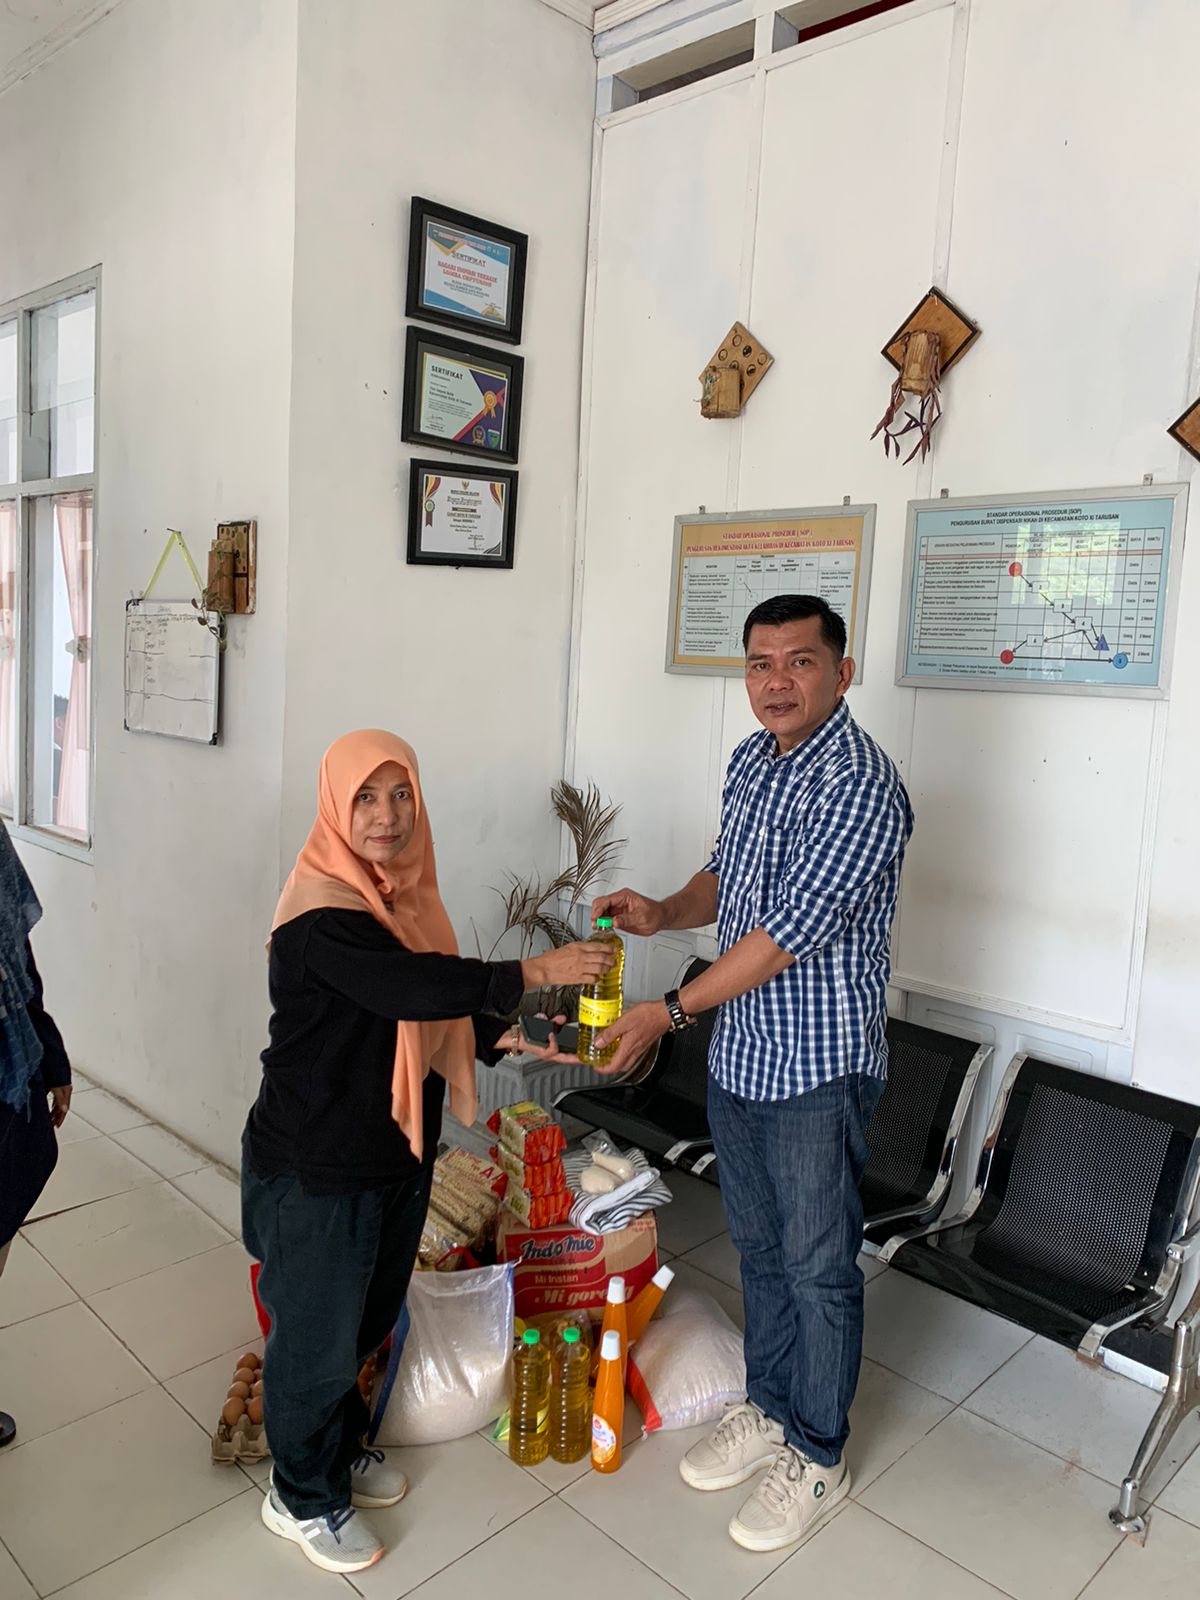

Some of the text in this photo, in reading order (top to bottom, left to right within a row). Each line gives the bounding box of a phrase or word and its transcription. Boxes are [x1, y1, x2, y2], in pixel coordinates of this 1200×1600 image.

[431, 365, 463, 380] SERTIFIKAT
[535, 1273, 579, 1283] Mi Instan
[543, 1286, 635, 1305] Mi goreg
